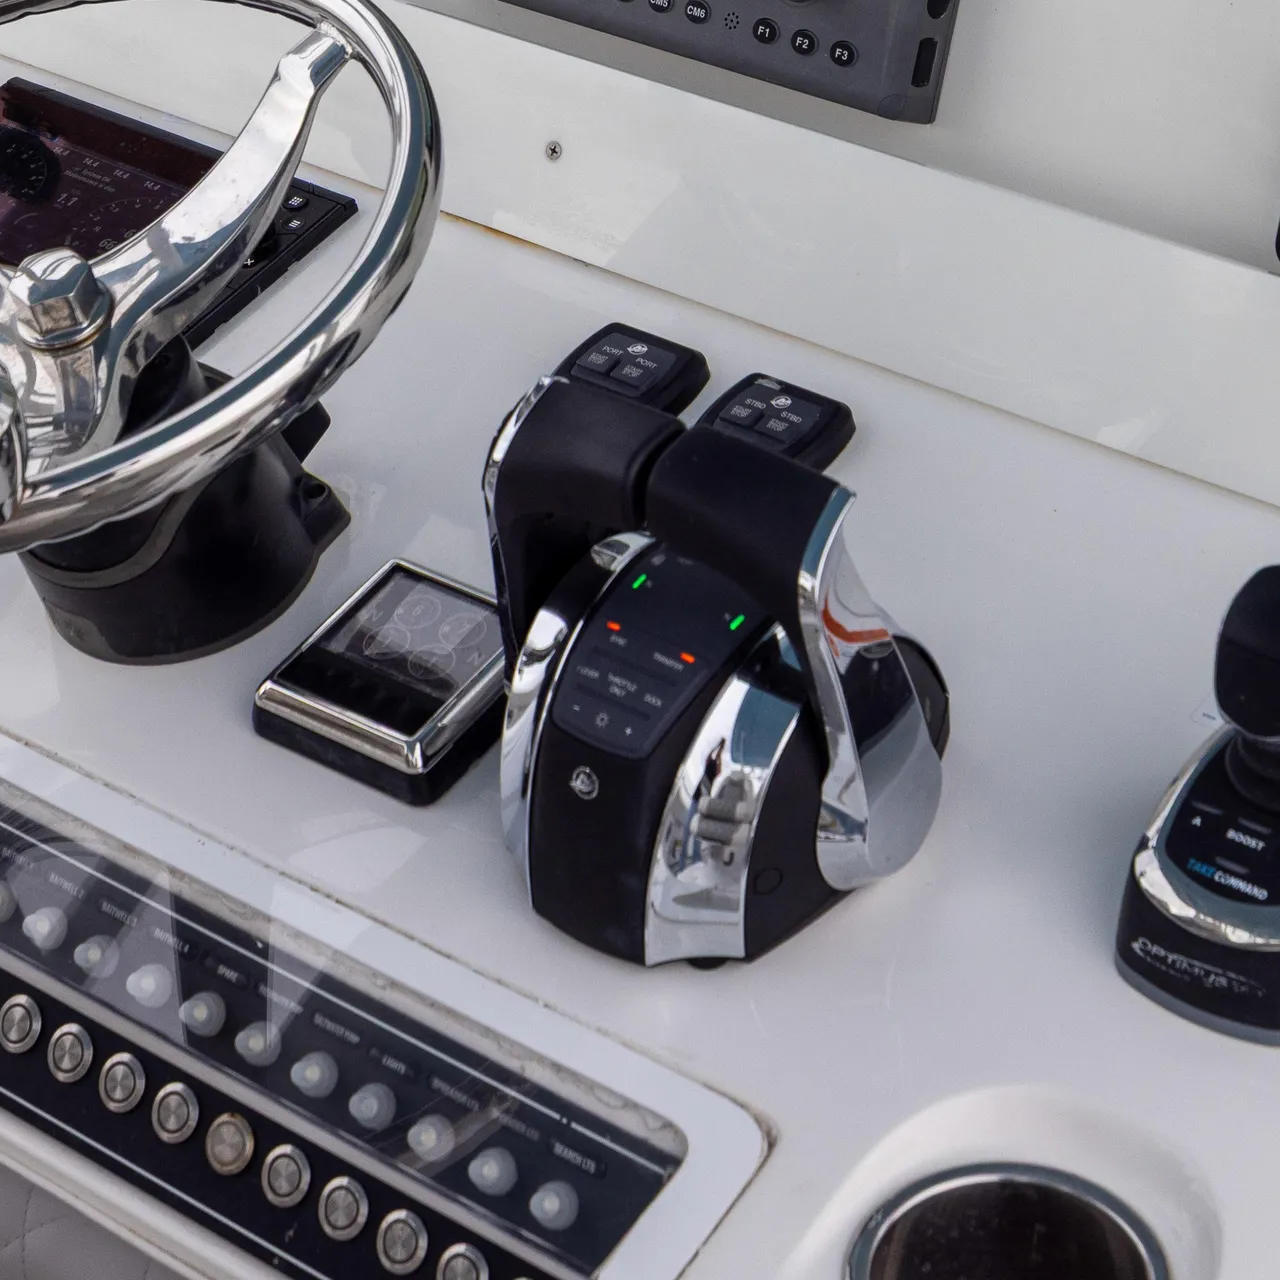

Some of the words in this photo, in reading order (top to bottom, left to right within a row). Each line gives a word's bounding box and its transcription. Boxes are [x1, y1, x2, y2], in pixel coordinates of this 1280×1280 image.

[686, 4, 707, 19] CM6
[757, 24, 770, 38] F1
[795, 36, 810, 50] F2
[834, 47, 849, 61] F3
[602, 344, 624, 357] PORT
[635, 356, 658, 370] PORT
[744, 397, 767, 410] STBD
[780, 410, 803, 424] STBD
[1191, 815, 1202, 827] A
[1225, 827, 1266, 852] BOOST
